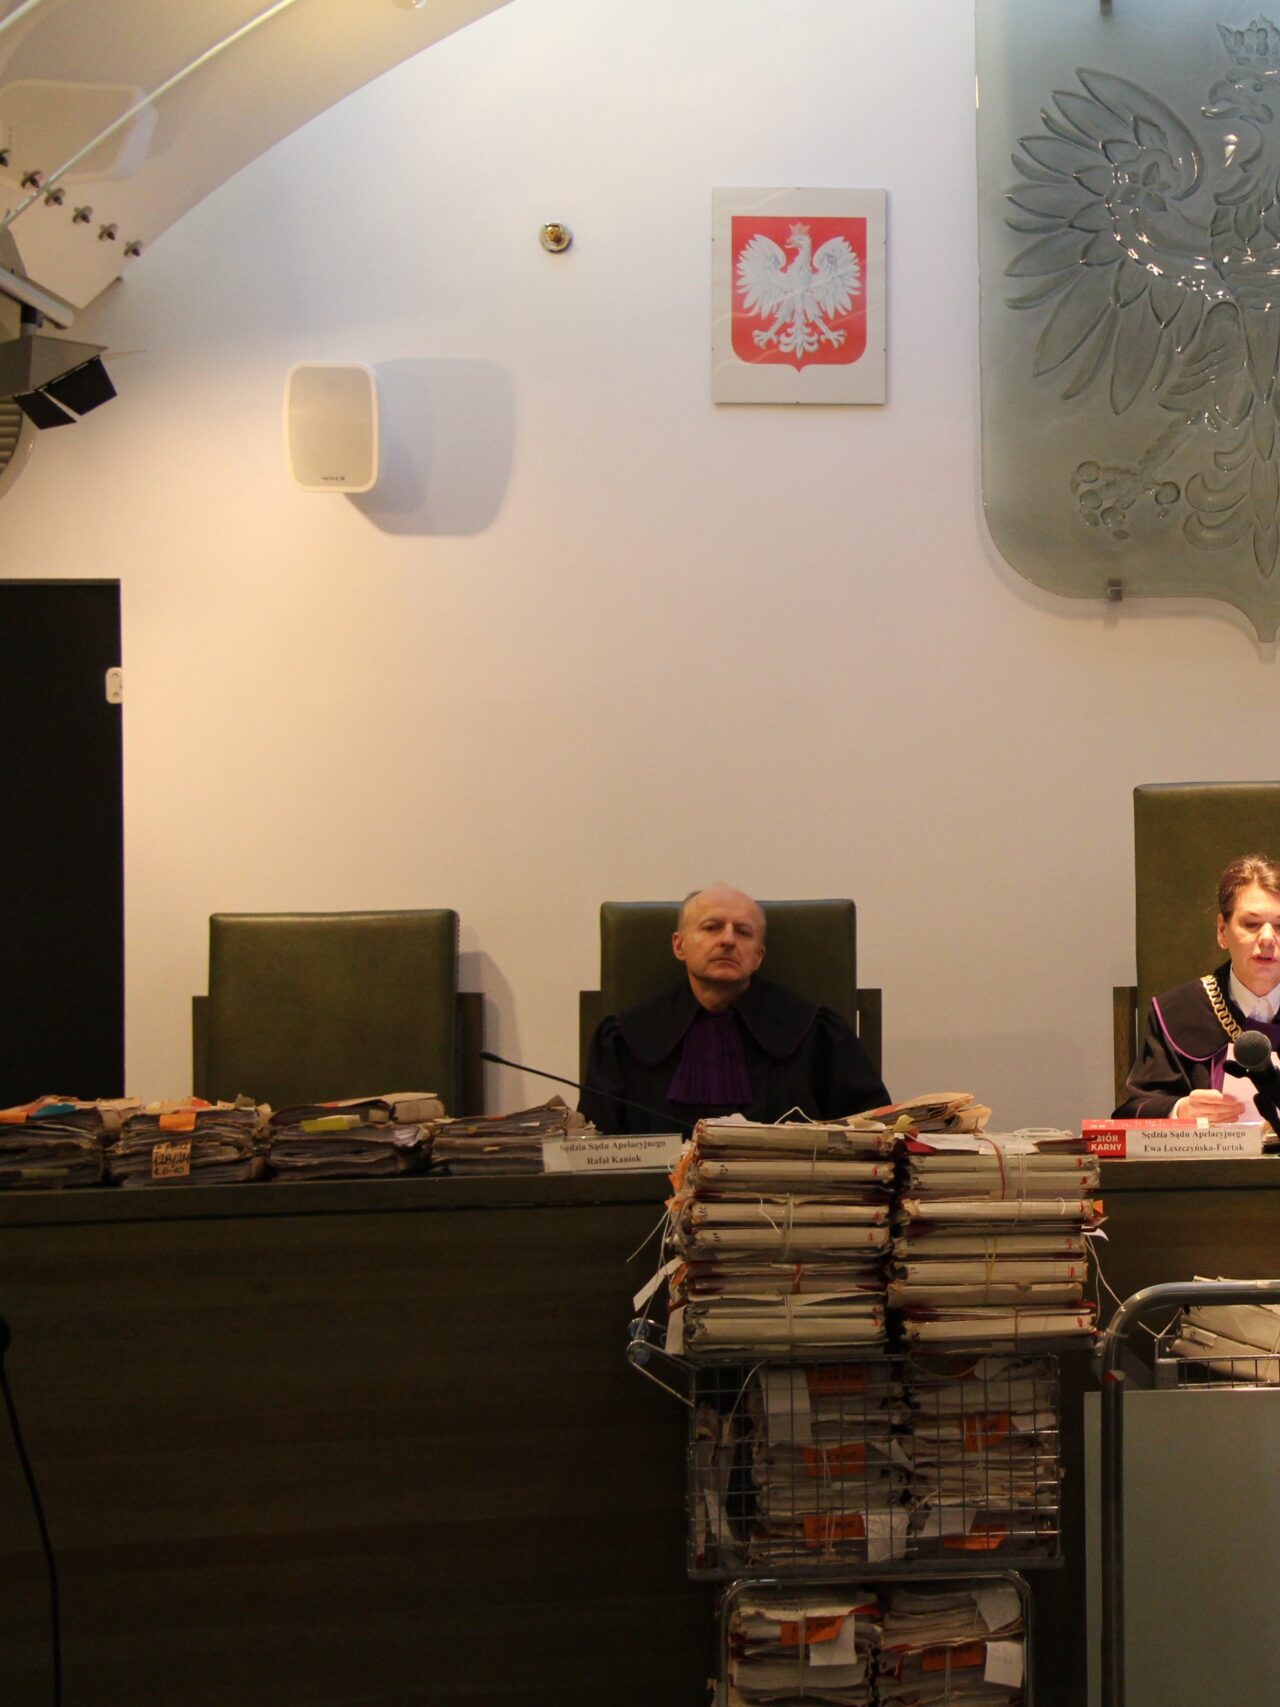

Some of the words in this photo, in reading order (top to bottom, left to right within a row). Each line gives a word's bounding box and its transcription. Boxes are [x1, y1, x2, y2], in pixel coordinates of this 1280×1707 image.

[1142, 1130, 1168, 1140] Sędzia
[1170, 1130, 1190, 1140] Sądu
[1192, 1129, 1246, 1140] Apelacyjnego
[560, 1143, 586, 1153] Sędzia
[588, 1143, 609, 1152] Sądu
[612, 1139, 666, 1150] Apelacyjnego
[1091, 1143, 1122, 1151] KARNY
[587, 1157, 610, 1165] Rafał
